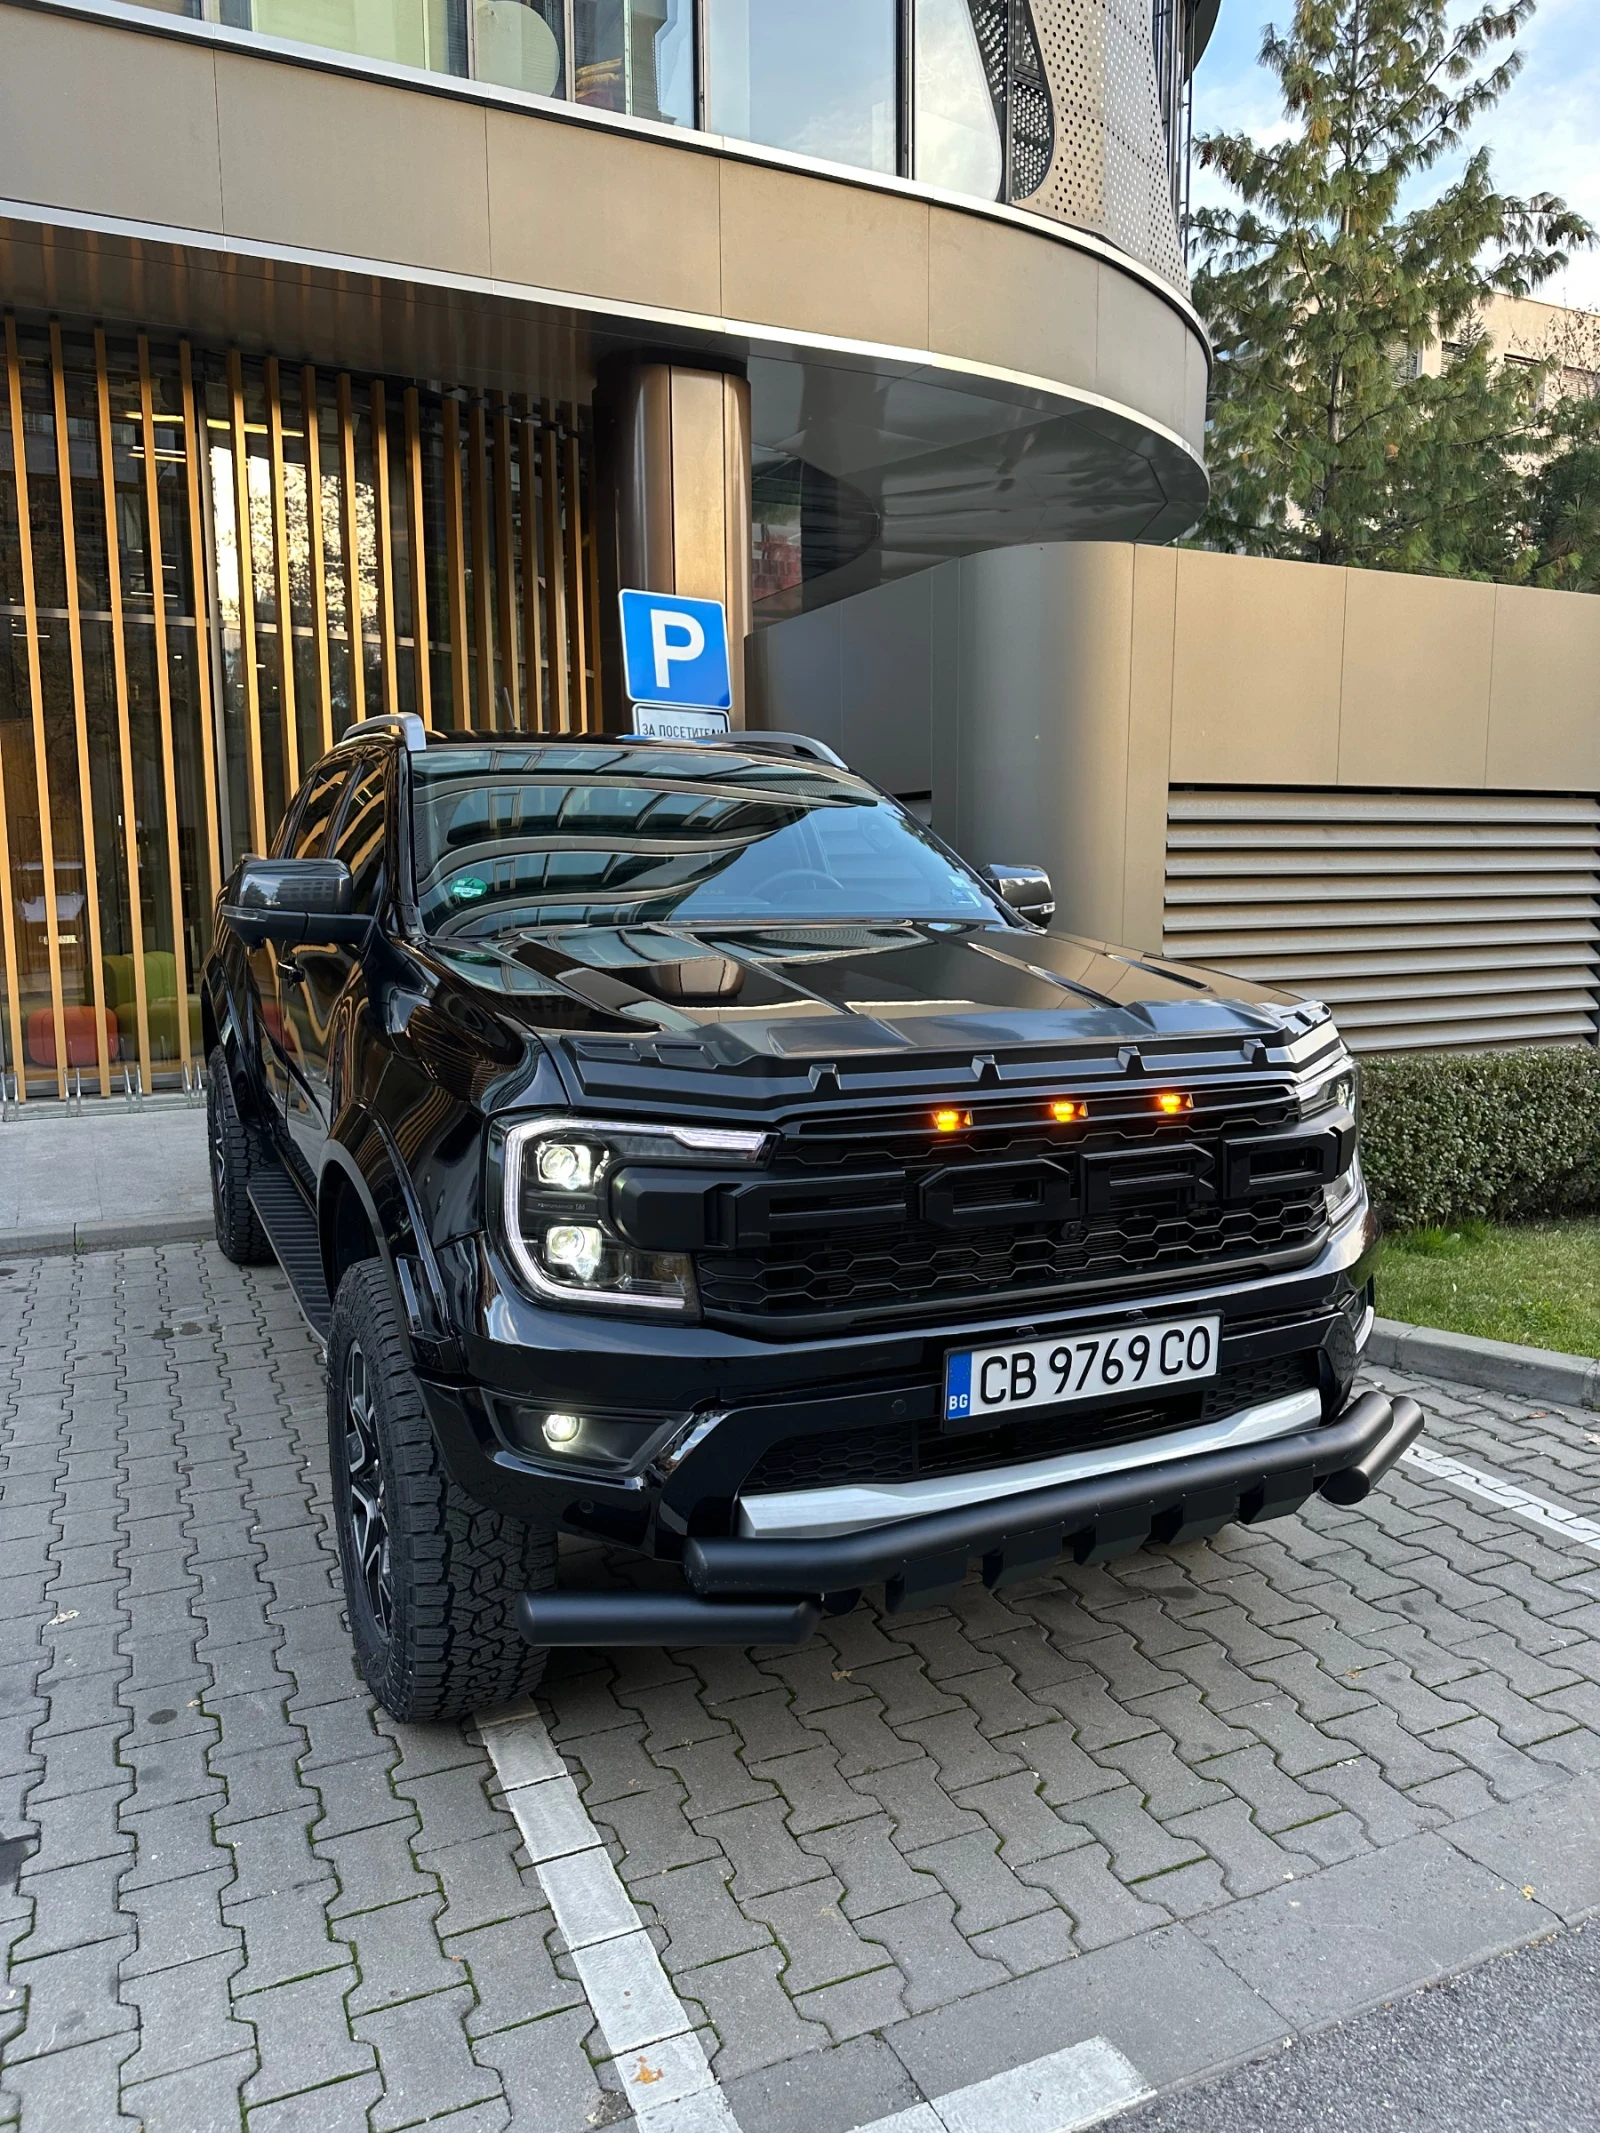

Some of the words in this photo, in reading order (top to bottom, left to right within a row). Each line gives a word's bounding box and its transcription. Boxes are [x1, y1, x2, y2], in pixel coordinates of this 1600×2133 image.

[650, 608, 705, 688] P
[642, 723, 656, 736] ЗА
[464, 878, 475, 888] 4
[731, 1130, 1341, 1249] FORD
[980, 1351, 1037, 1405] CB
[1049, 1334, 1150, 1395] 9769
[949, 1394, 968, 1410] BG
